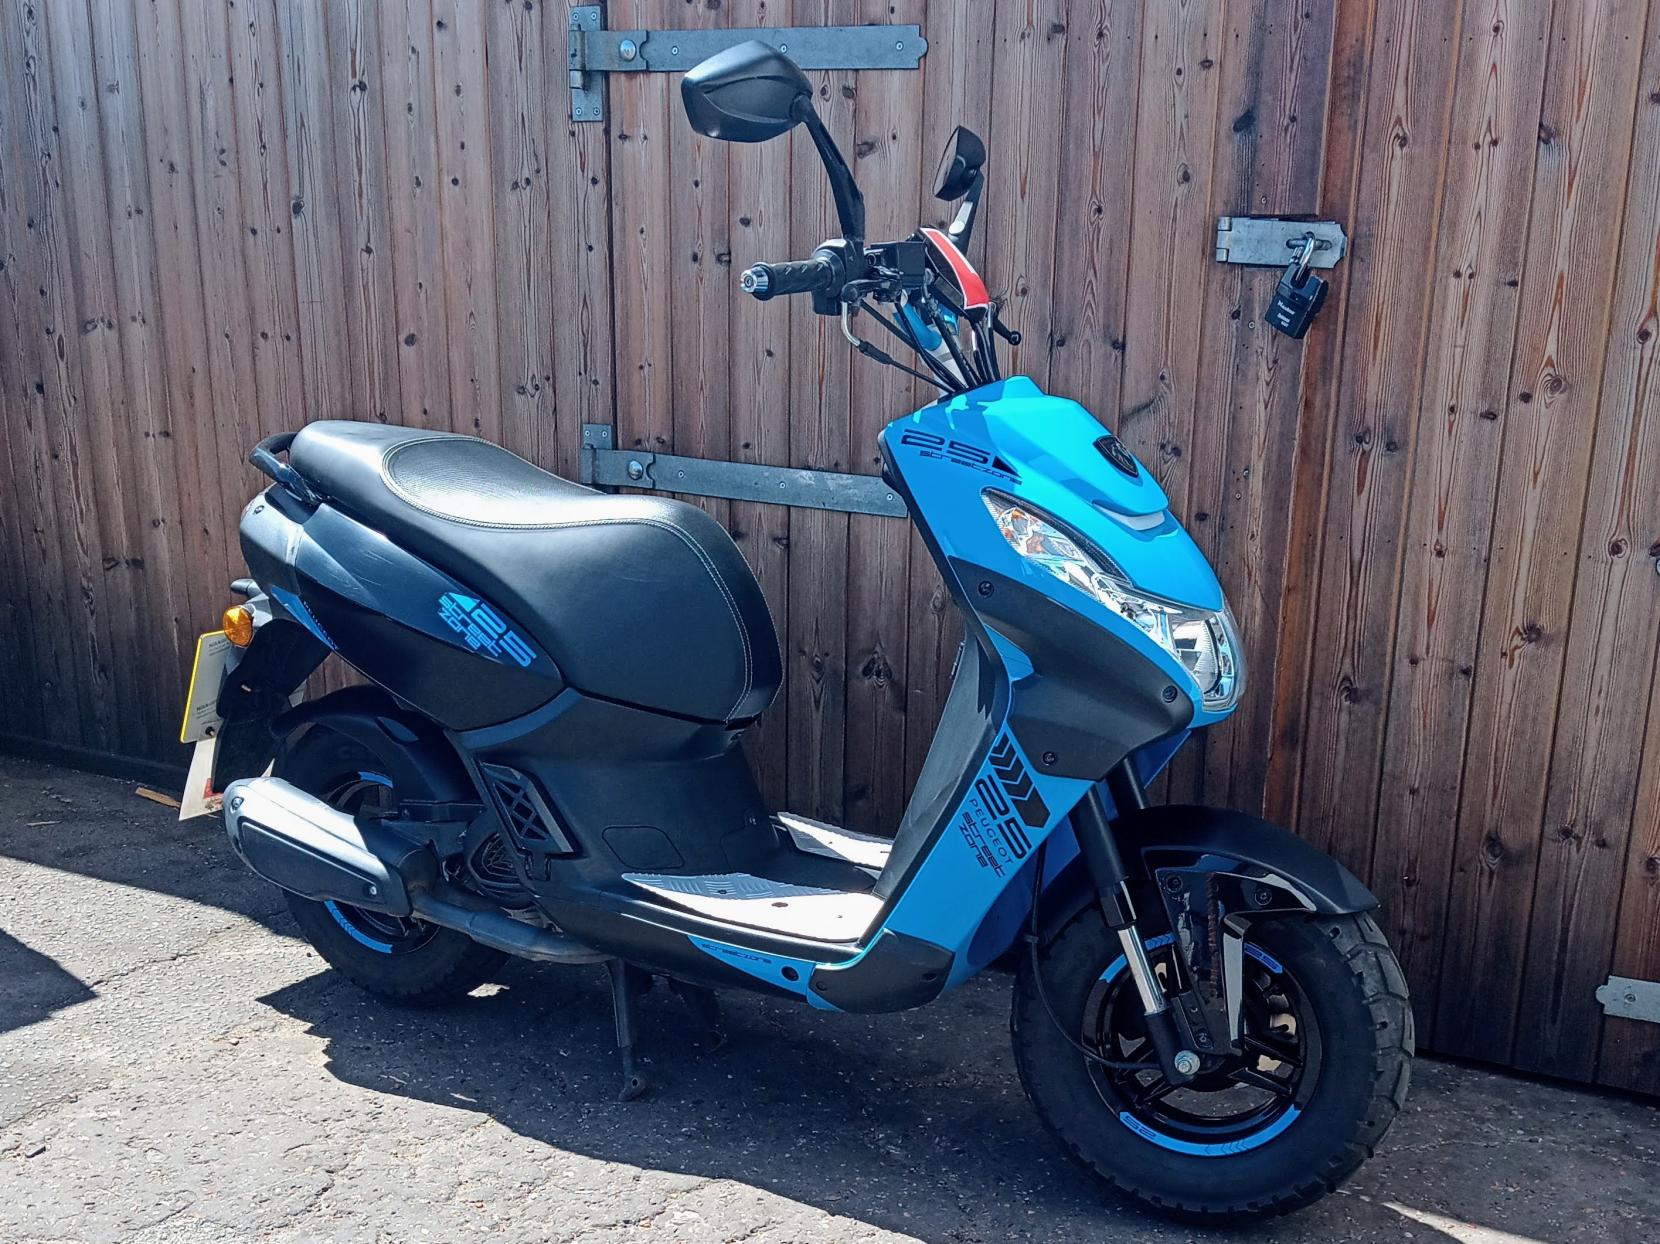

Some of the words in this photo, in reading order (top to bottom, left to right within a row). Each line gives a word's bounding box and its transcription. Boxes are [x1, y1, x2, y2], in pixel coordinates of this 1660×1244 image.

[437, 607, 481, 650] zone
[438, 595, 502, 657] street
[958, 822, 989, 869] zone
[962, 811, 1006, 878] street
[968, 798, 1014, 864] PEUGEOT
